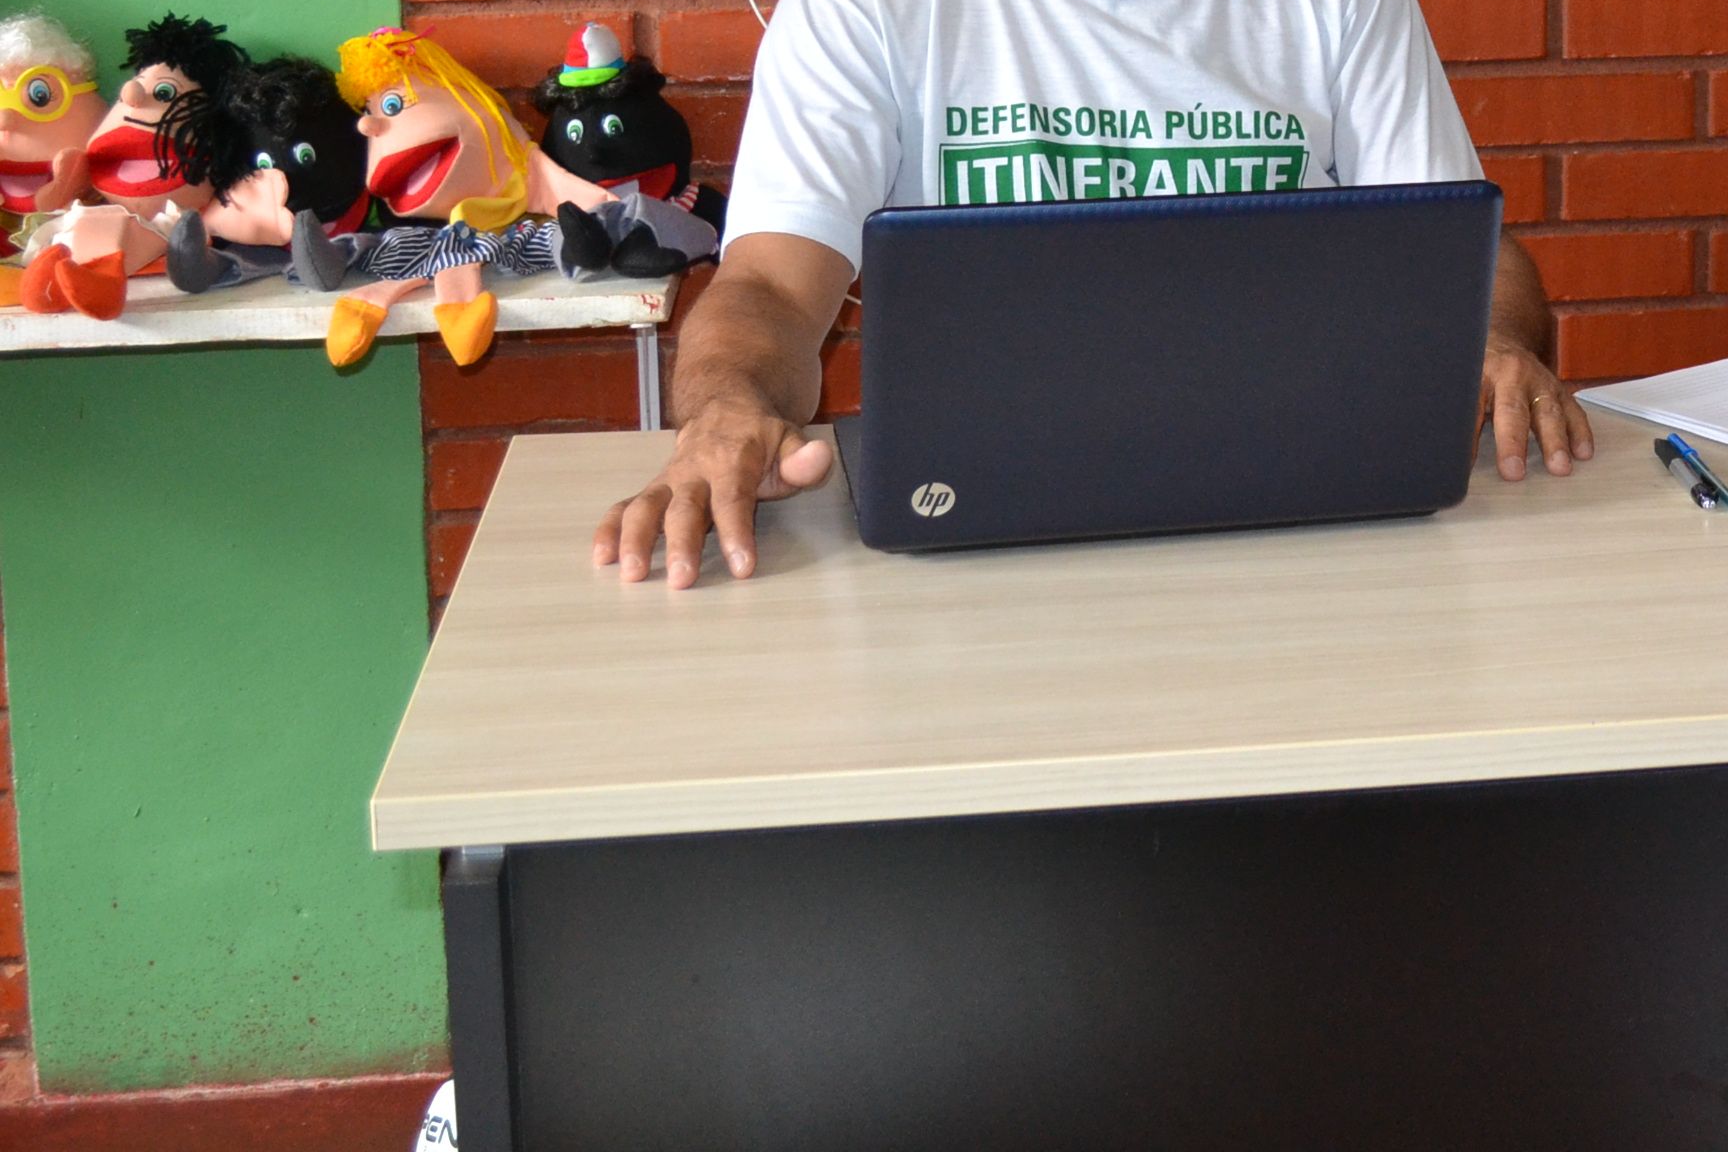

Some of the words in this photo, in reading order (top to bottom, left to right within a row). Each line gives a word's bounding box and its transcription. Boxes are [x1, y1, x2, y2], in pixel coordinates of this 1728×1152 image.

[946, 103, 1152, 139] DEFENSORIA
[1165, 103, 1305, 140] PÚBLICA
[956, 153, 1292, 205] ITINERANTE
[918, 482, 951, 517] hp
